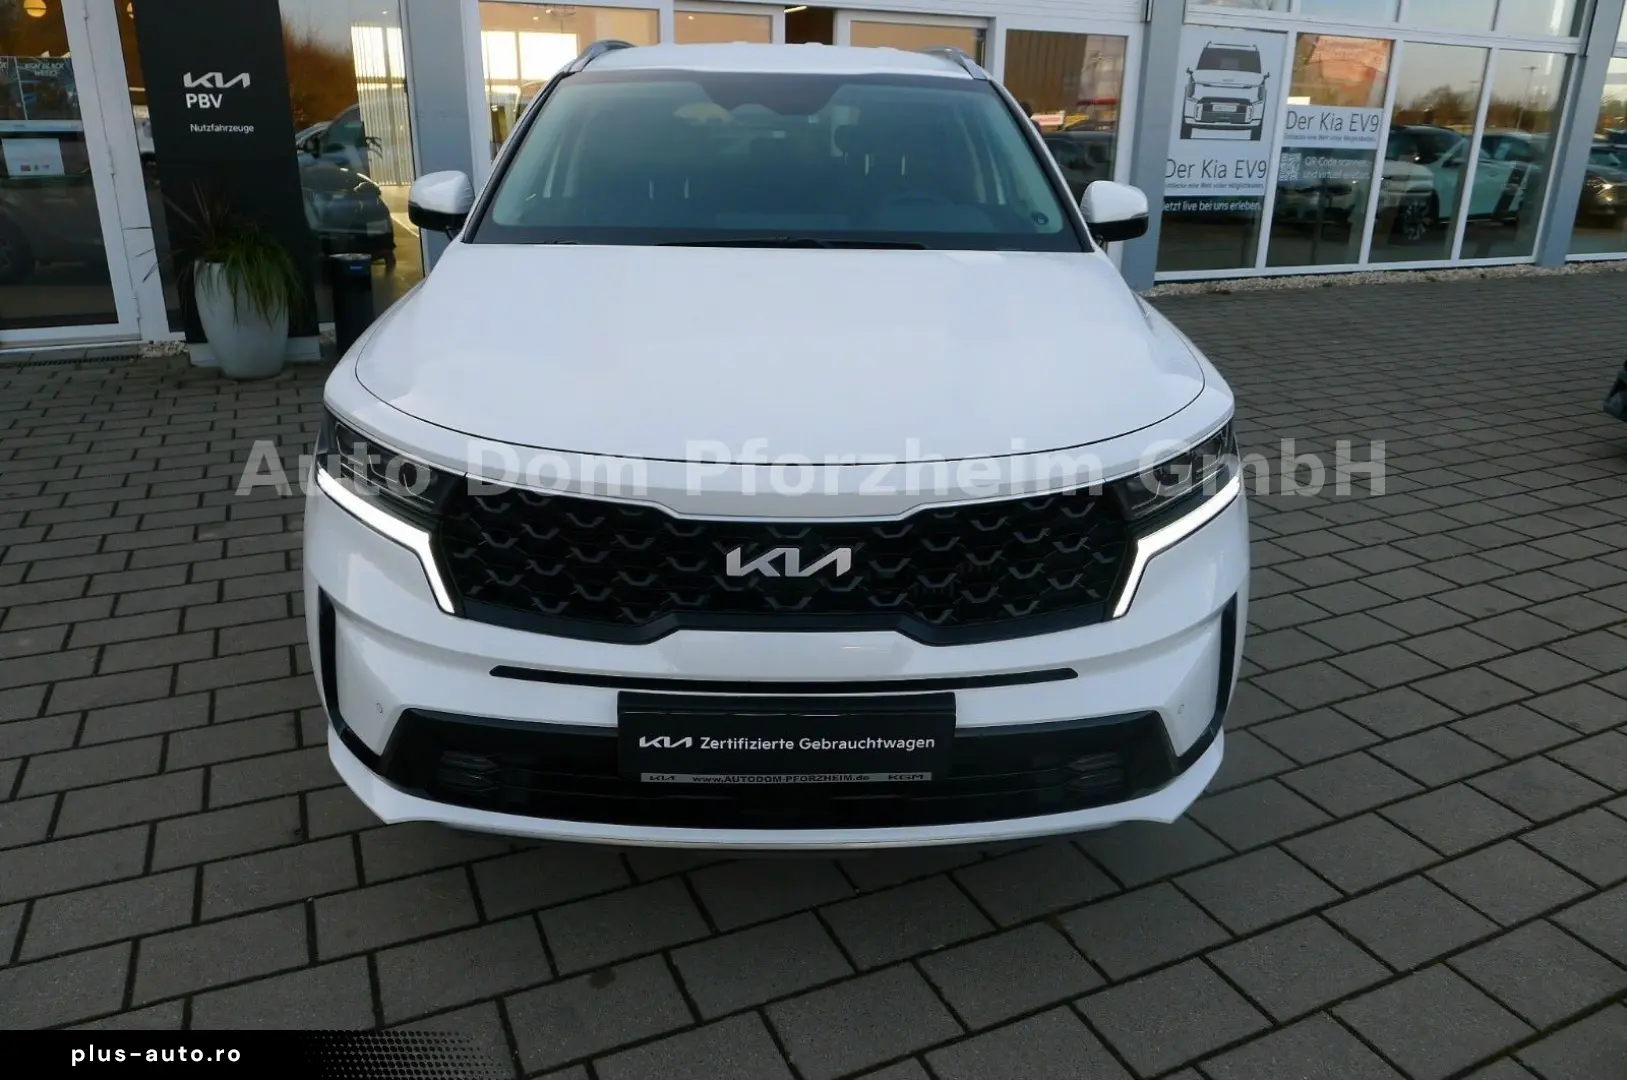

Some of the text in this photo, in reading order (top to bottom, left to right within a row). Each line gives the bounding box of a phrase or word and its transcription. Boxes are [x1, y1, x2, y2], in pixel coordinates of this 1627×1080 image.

[183, 72, 250, 88] KIA
[186, 93, 222, 108] PBV
[190, 123, 254, 133] Nutzfahrzeuge
[1286, 110, 1380, 132] Der Kia EV9
[1165, 158, 1267, 179] Der Kia EV9
[1183, 201, 1197, 211] live
[1200, 201, 1213, 211] bei
[1214, 202, 1229, 211] uns
[726, 547, 852, 577] KIA
[639, 736, 936, 751] KIA Zertifizierte Gebrauchtwagen
[692, 774, 870, 783] www.AUTODOM-PFORZHEIM.de
